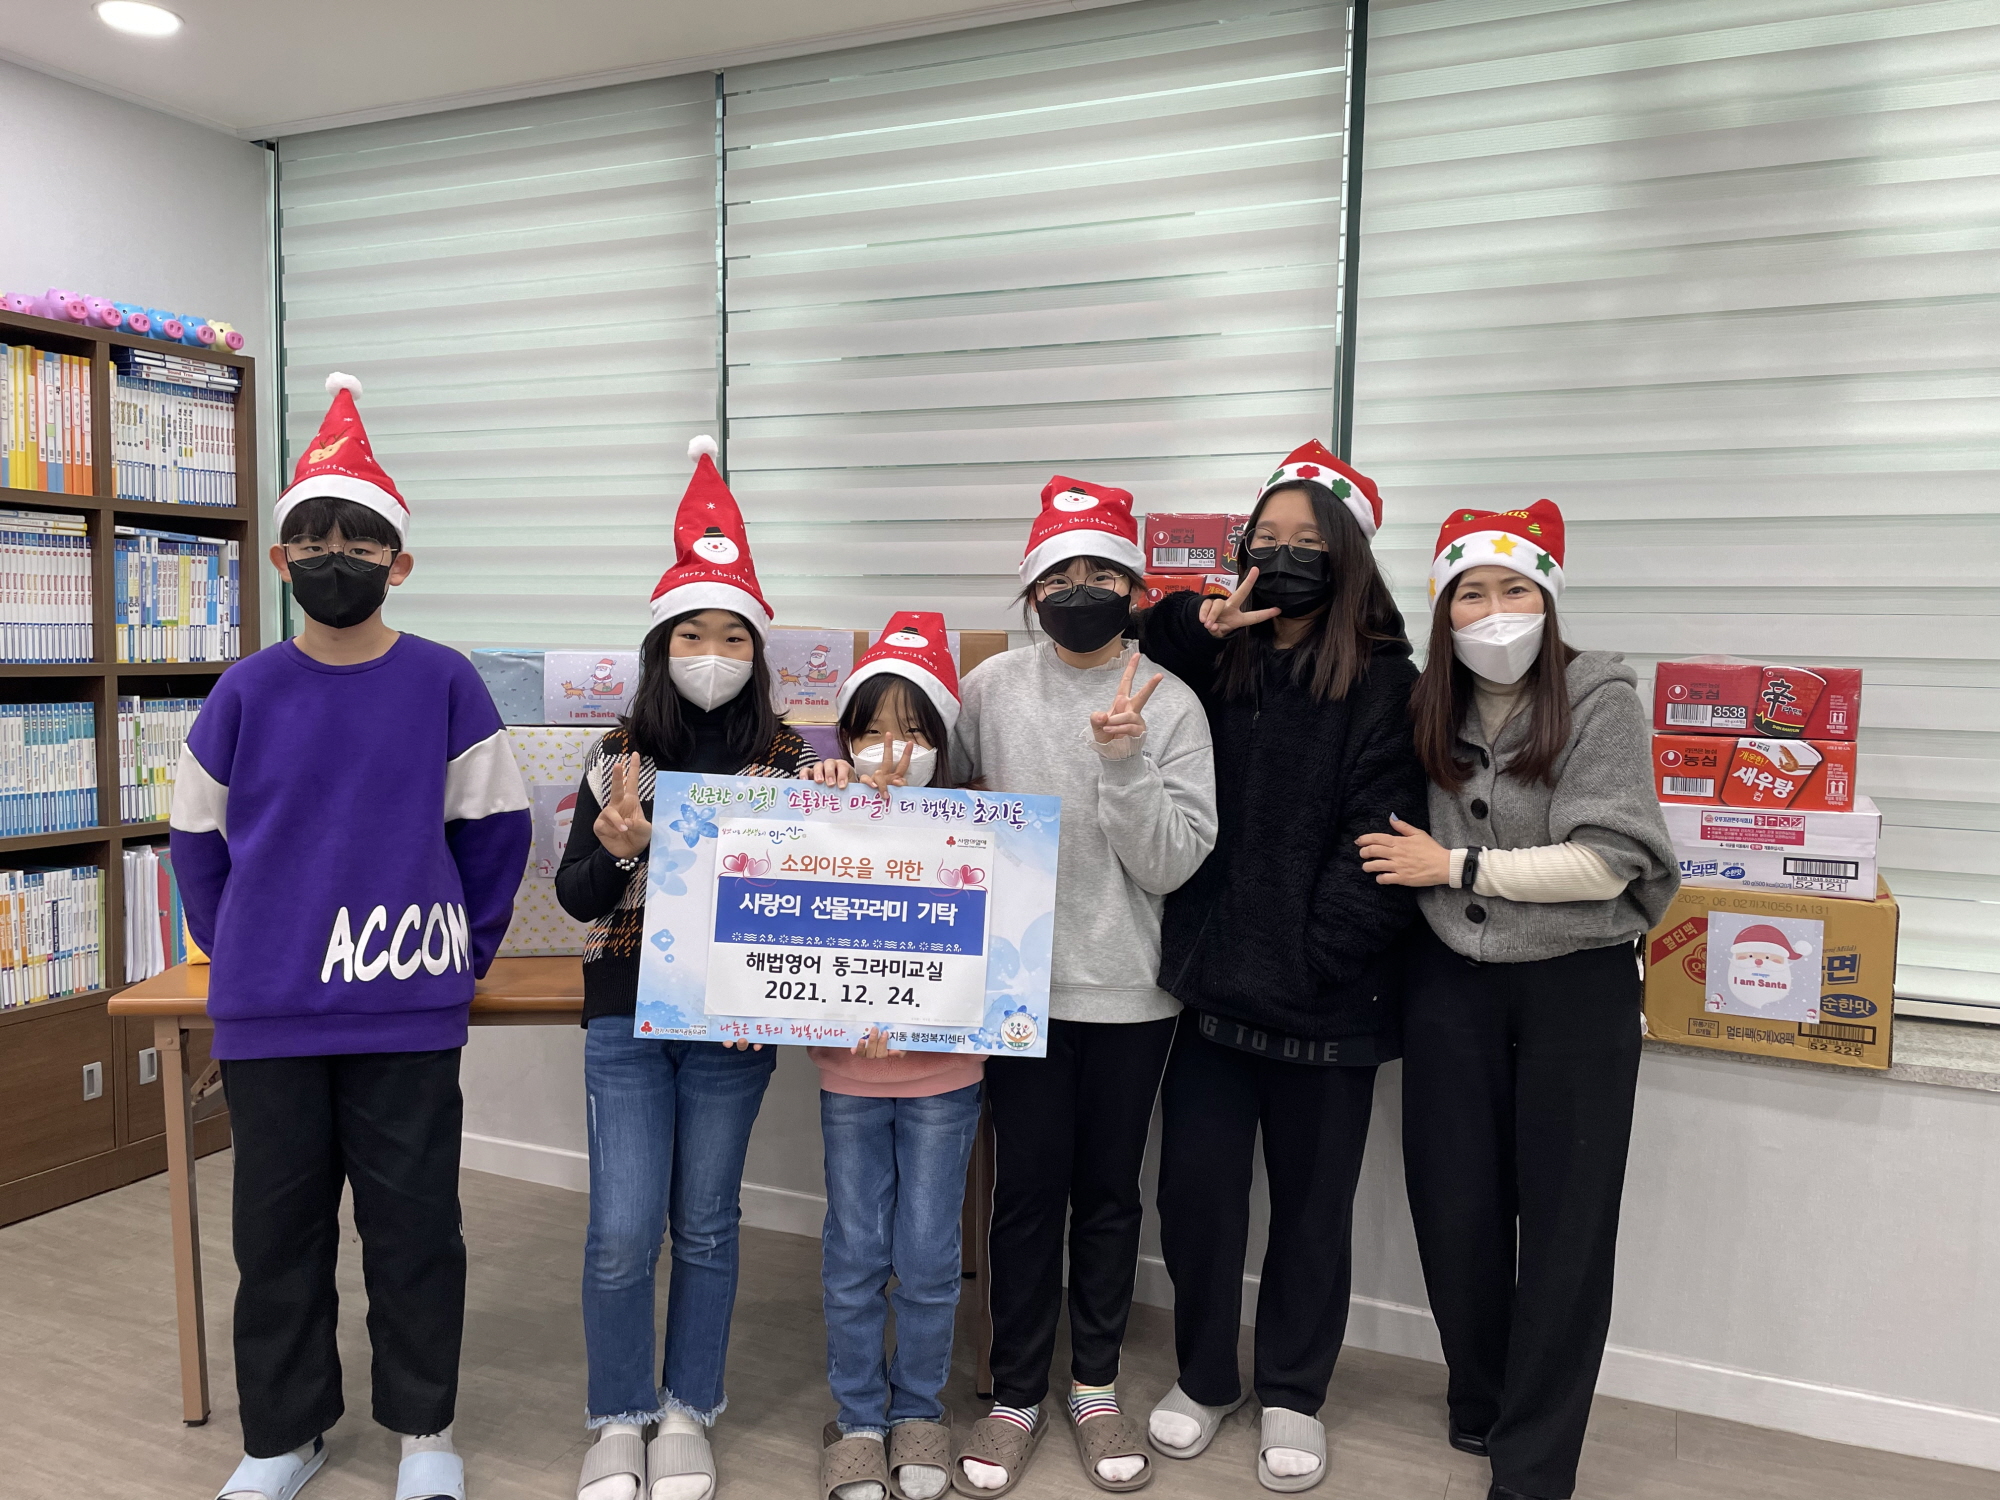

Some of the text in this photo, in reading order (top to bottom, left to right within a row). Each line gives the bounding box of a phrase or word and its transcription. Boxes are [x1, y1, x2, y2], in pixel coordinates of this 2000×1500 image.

[1170, 534, 1194, 544] 농심
[1190, 549, 1215, 558] 3538
[1690, 688, 1720, 700] 농심
[1762, 679, 1797, 718] 辛
[804, 698, 830, 706] Santa
[1714, 706, 1746, 718] 3538
[1684, 755, 1717, 767] 농심
[1739, 751, 1769, 767] 개운한!
[1732, 766, 1795, 798] 새우탕
[1753, 792, 1764, 802] 컵
[690, 785, 1028, 830] 친근한 이웃! 소통하는 마을! 더 행복한 초지동
[780, 854, 924, 882] 소외이웃을 위한
[1795, 881, 1842, 891] 52 121
[739, 893, 959, 926] 사랑의 선물꾸러미 기탁
[1662, 922, 1698, 950] 멀티팩
[746, 952, 944, 982] 해법영어 동그라미교실
[1734, 976, 1788, 990] I am Santa
[764, 980, 920, 1008] 2021. 12. 24.
[1822, 997, 1872, 1016] 순한맛
[720, 1021, 850, 1042] 나눔은 모두의 행복입니다.
[1692, 1020, 1716, 1030] 유통기간
[887, 1032, 966, 1044] 지동 행정복지센터
[1236, 1023, 1268, 1050] TO
[1284, 1037, 1340, 1062] DIE
[1810, 1042, 1828, 1051] 52
[1834, 1046, 1862, 1056] 225
